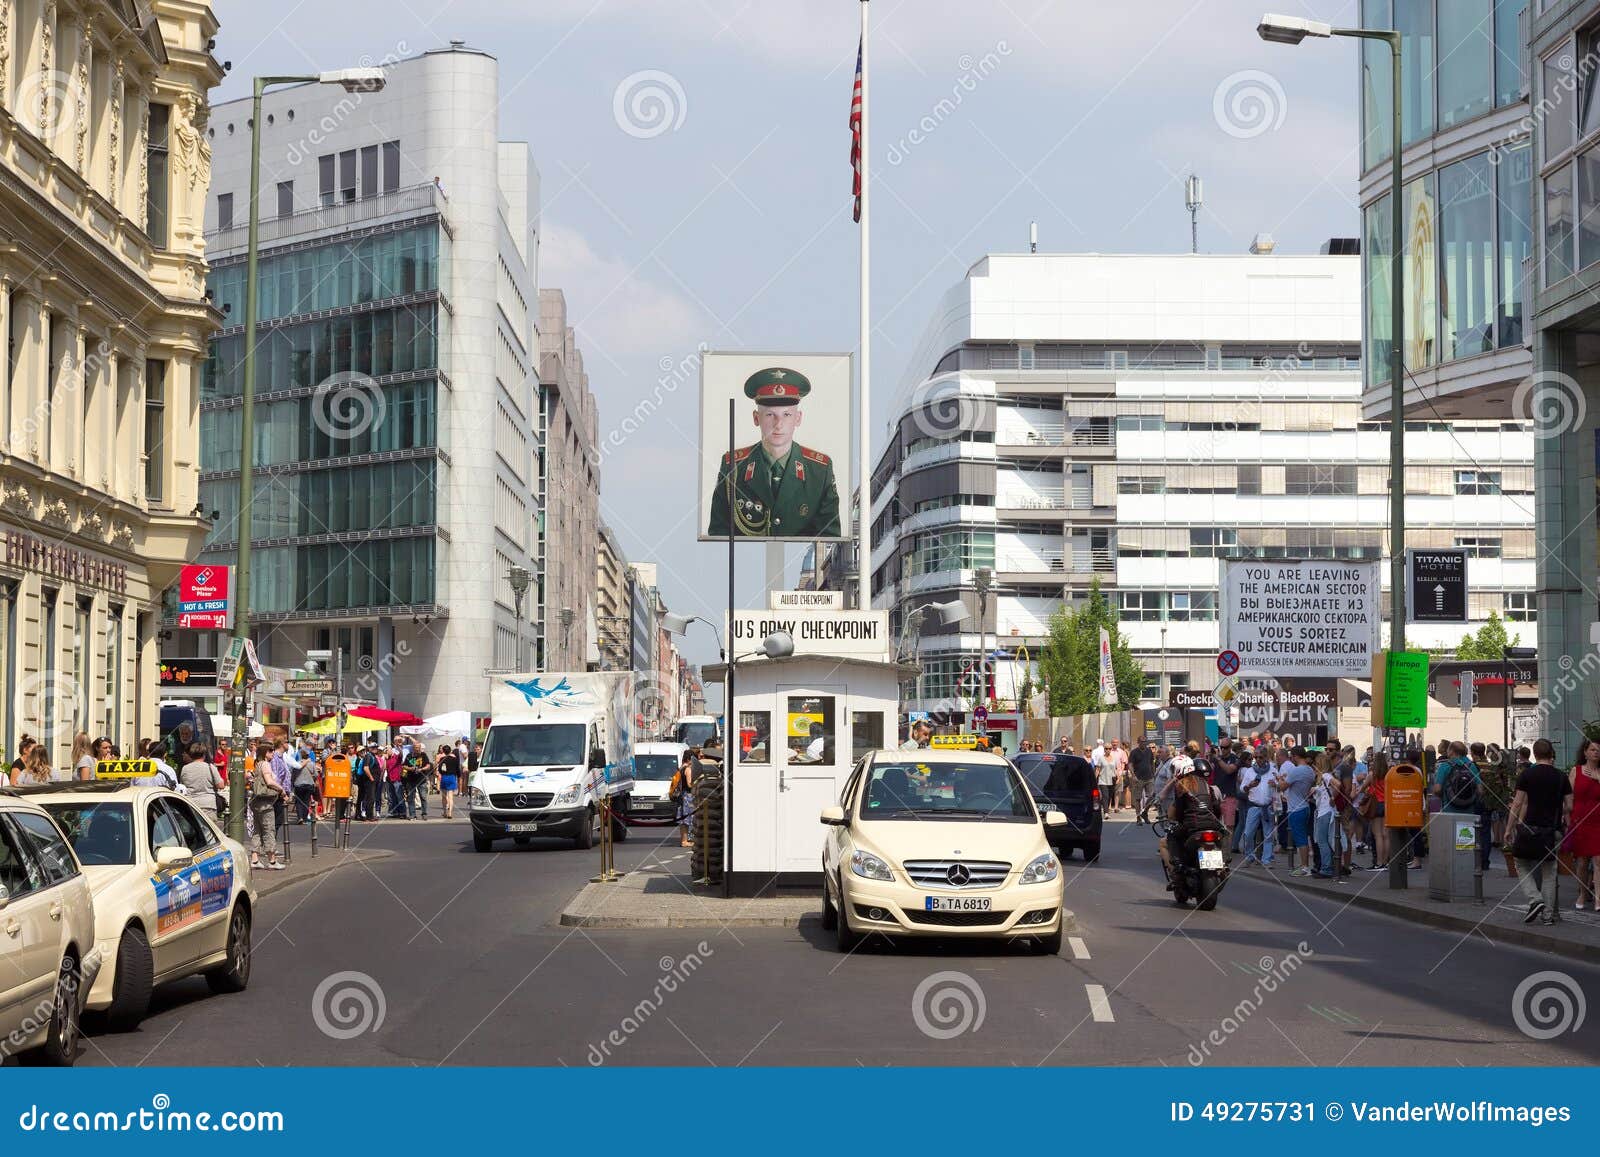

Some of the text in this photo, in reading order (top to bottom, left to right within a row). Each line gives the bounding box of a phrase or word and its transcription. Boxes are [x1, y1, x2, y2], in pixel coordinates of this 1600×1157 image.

[1246, 569, 1360, 581] YOU ARE LEAVING
[1239, 583, 1367, 595] THE AMERICAN SECTOR
[780, 594, 833, 605] ALLIED CHECKPOINT
[1240, 598, 1364, 610] ВЫ ВЫЕЗЖАЕТЕ ИЗ
[184, 603, 197, 611] HOT
[205, 601, 224, 609] FRESH
[1238, 612, 1367, 624] АМЕРИКАНСКОГО СЕКТОРА
[801, 620, 879, 640] CHECKPOINT
[1259, 627, 1346, 640] VOUS SORTEZ
[1238, 641, 1252, 652] DU
[1257, 641, 1305, 653] SECTEUR
[1282, 658, 1294, 666] DEN
[1294, 659, 1345, 667] AMERIKANISCHEN
[1346, 659, 1367, 667] SEKTOR
[291, 681, 329, 690] Zimmerstraße
[1238, 692, 1274, 704] Charlie
[1280, 691, 1330, 703] BlackBox
[104, 762, 144, 772] TAXI
[933, 898, 990, 910] B TA 6819
